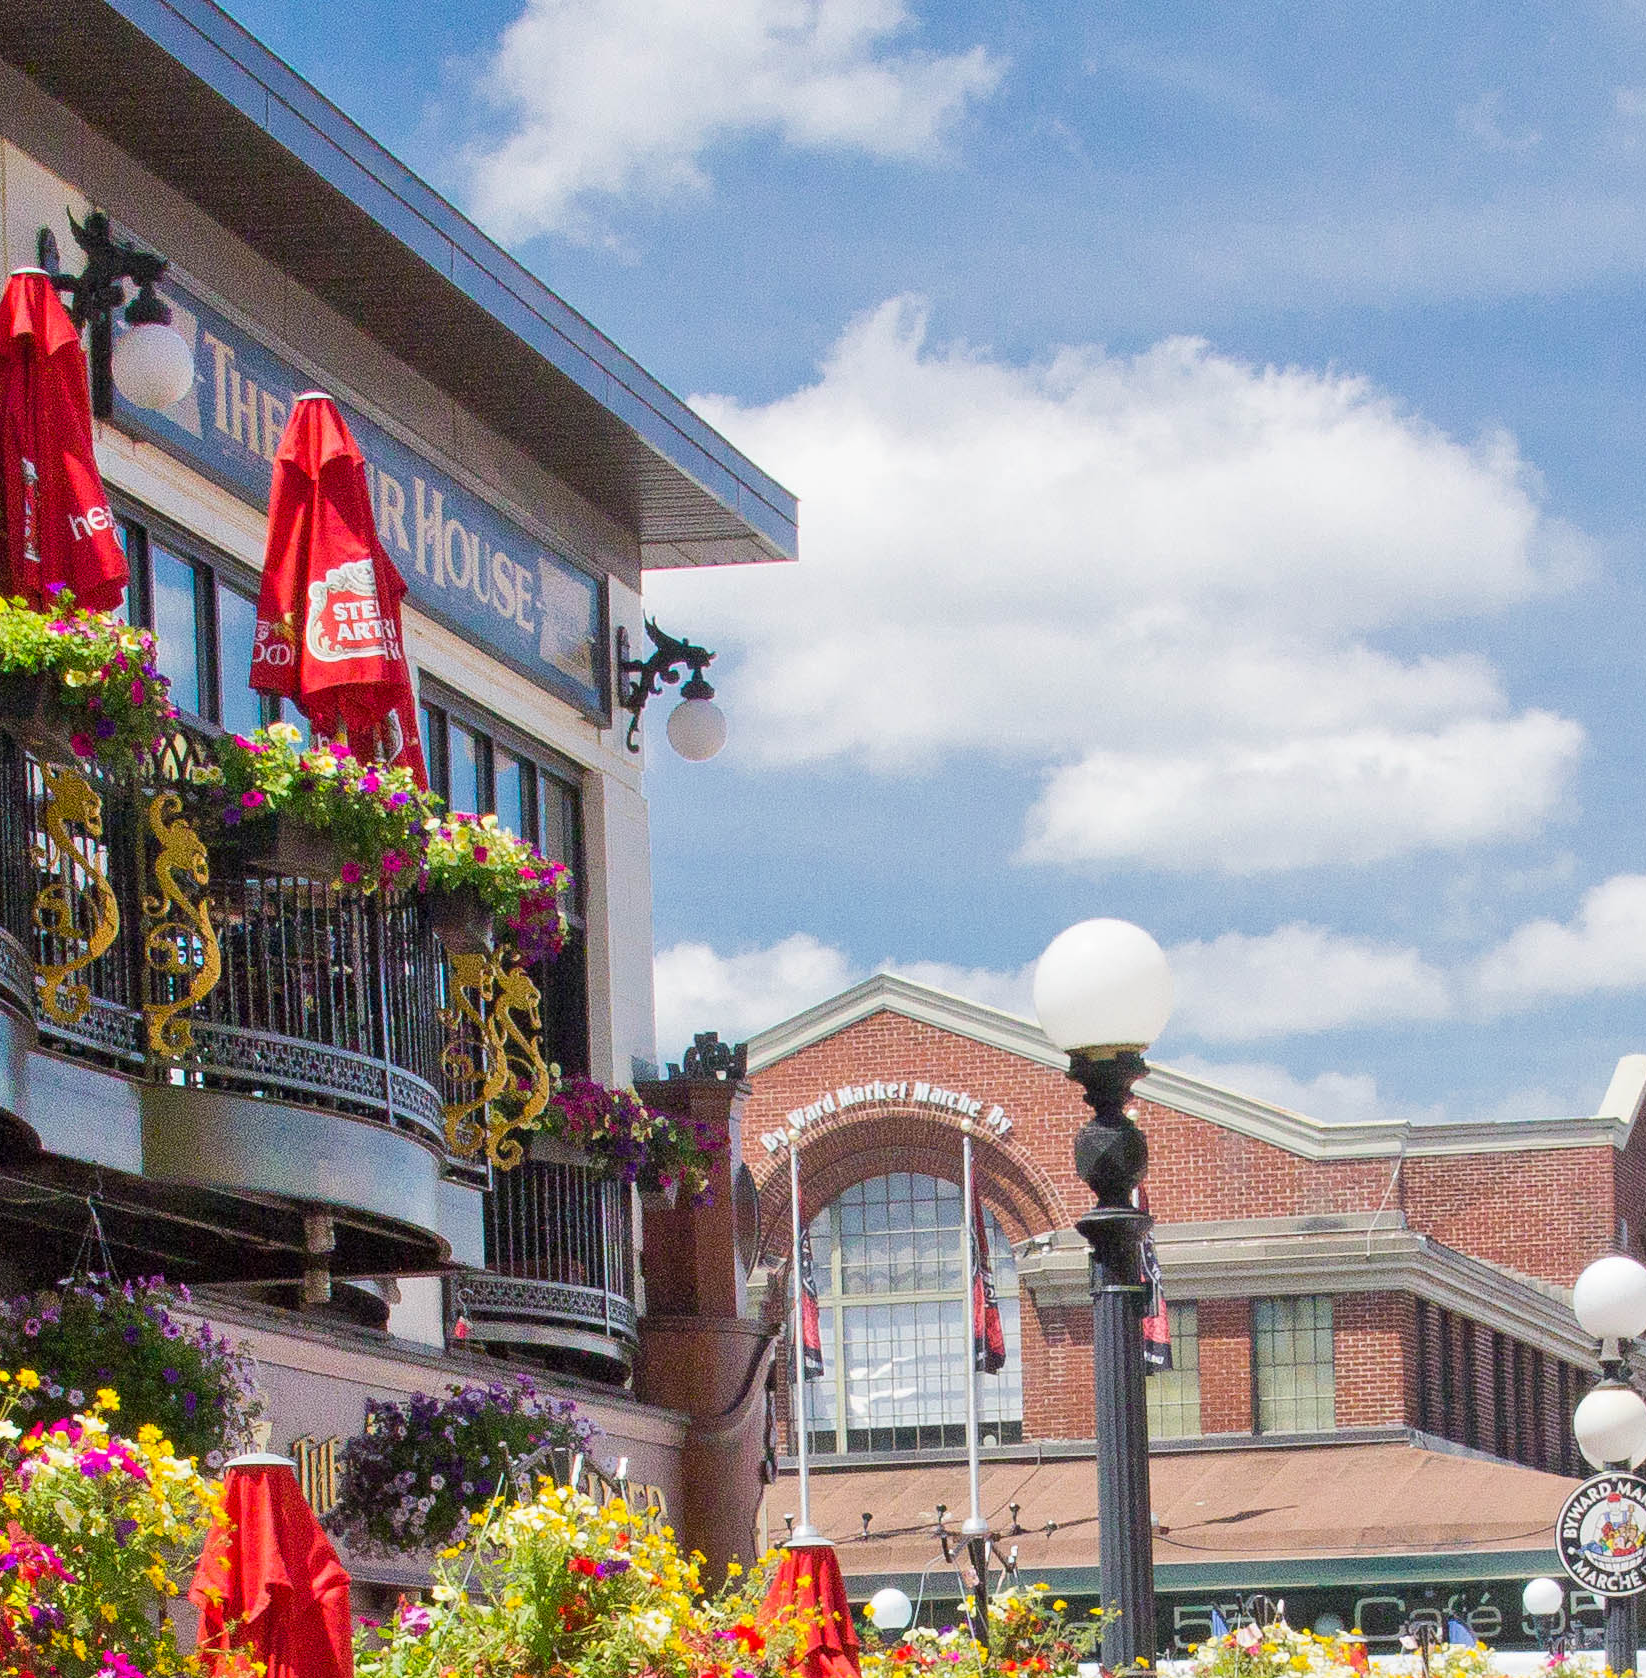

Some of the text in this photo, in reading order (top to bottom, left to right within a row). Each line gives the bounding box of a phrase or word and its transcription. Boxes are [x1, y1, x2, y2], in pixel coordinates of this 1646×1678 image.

[413, 476, 535, 633] HOUSE
[787, 1093, 837, 1130] Ward
[836, 1080, 908, 1107] Market
[986, 1105, 1014, 1135] By
[1562, 1482, 1612, 1539] BYWARD
[1572, 1559, 1643, 1590] MARCHÉ
[1354, 1592, 1502, 1641] Café
